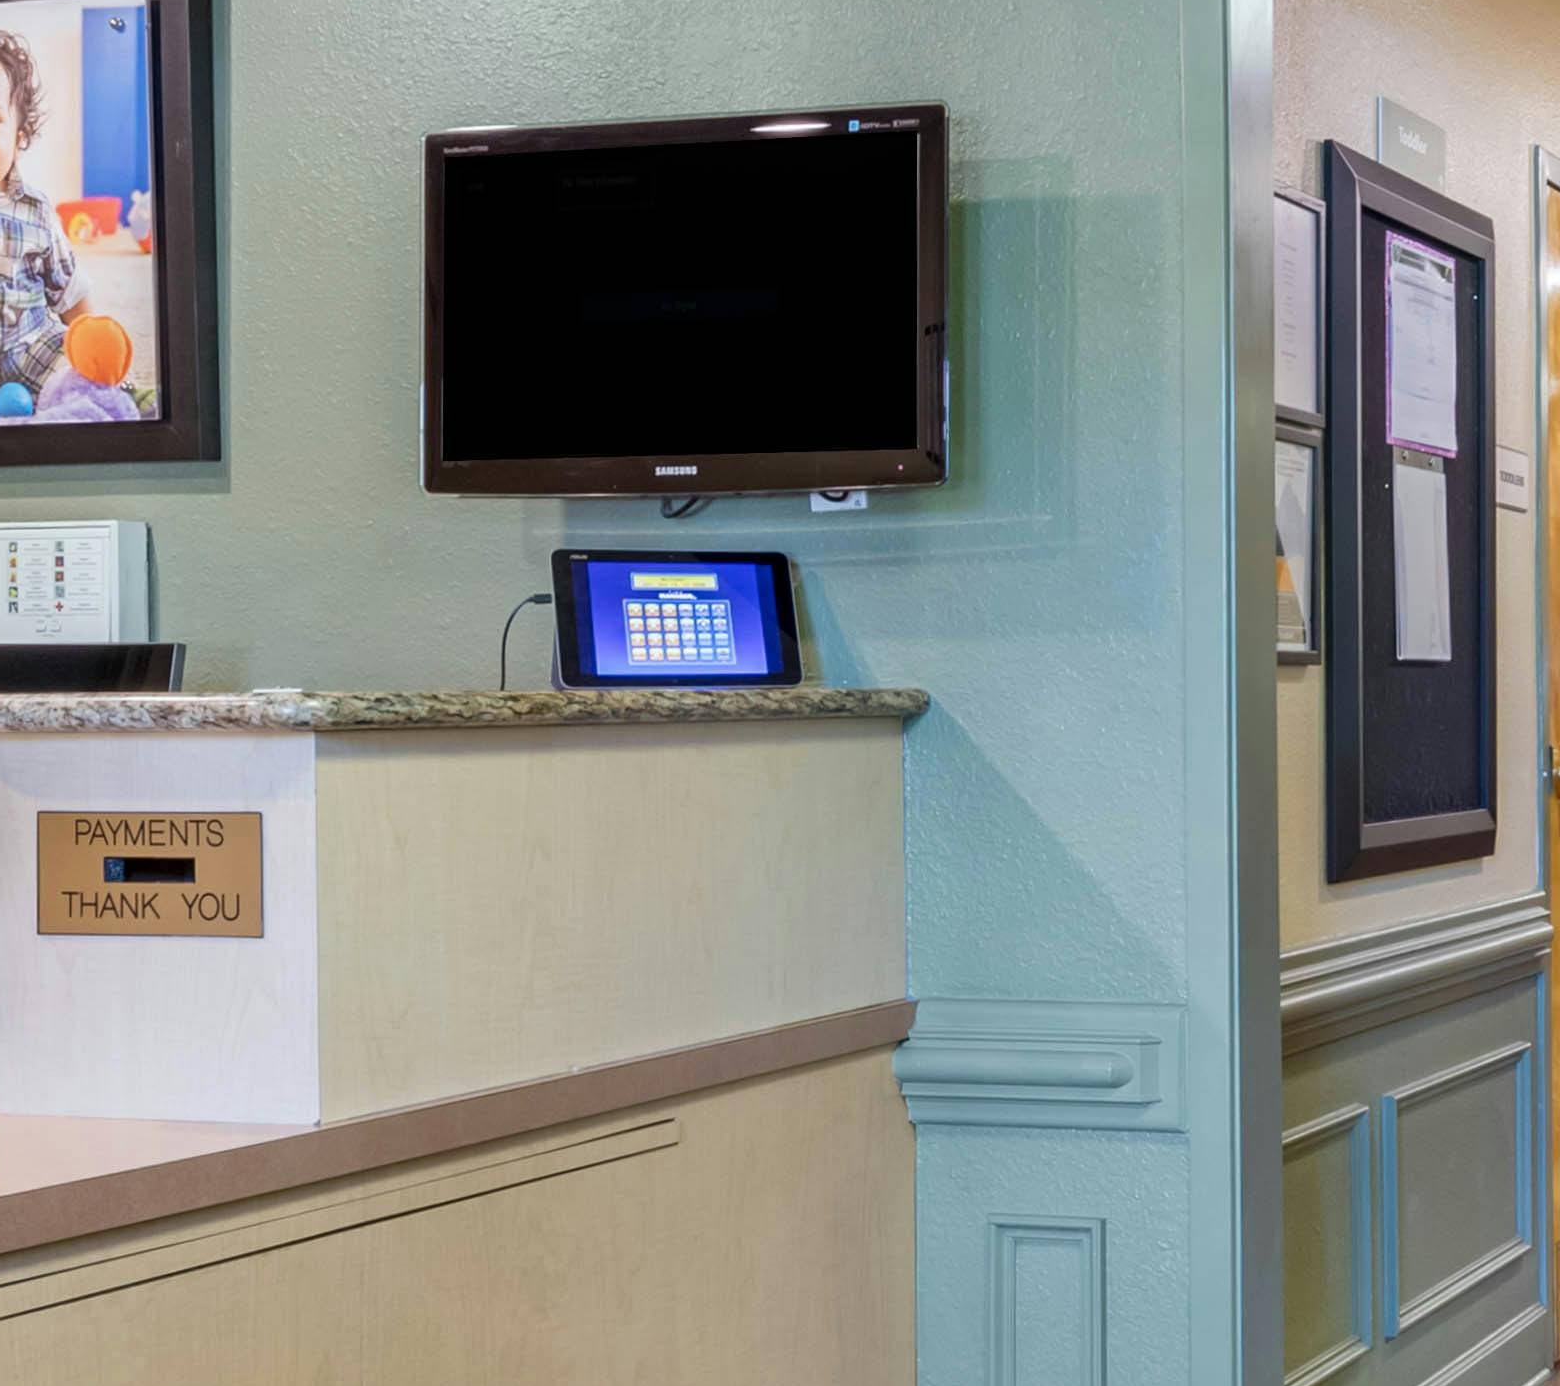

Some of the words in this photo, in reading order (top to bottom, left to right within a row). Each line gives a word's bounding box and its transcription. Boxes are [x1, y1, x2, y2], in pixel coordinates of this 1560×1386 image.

[1398, 126, 1428, 155] Toddler
[655, 465, 697, 476] SAMSUNG
[74, 818, 225, 847] PAYMENTS
[61, 891, 161, 920] THANK
[181, 892, 241, 921] YOU
